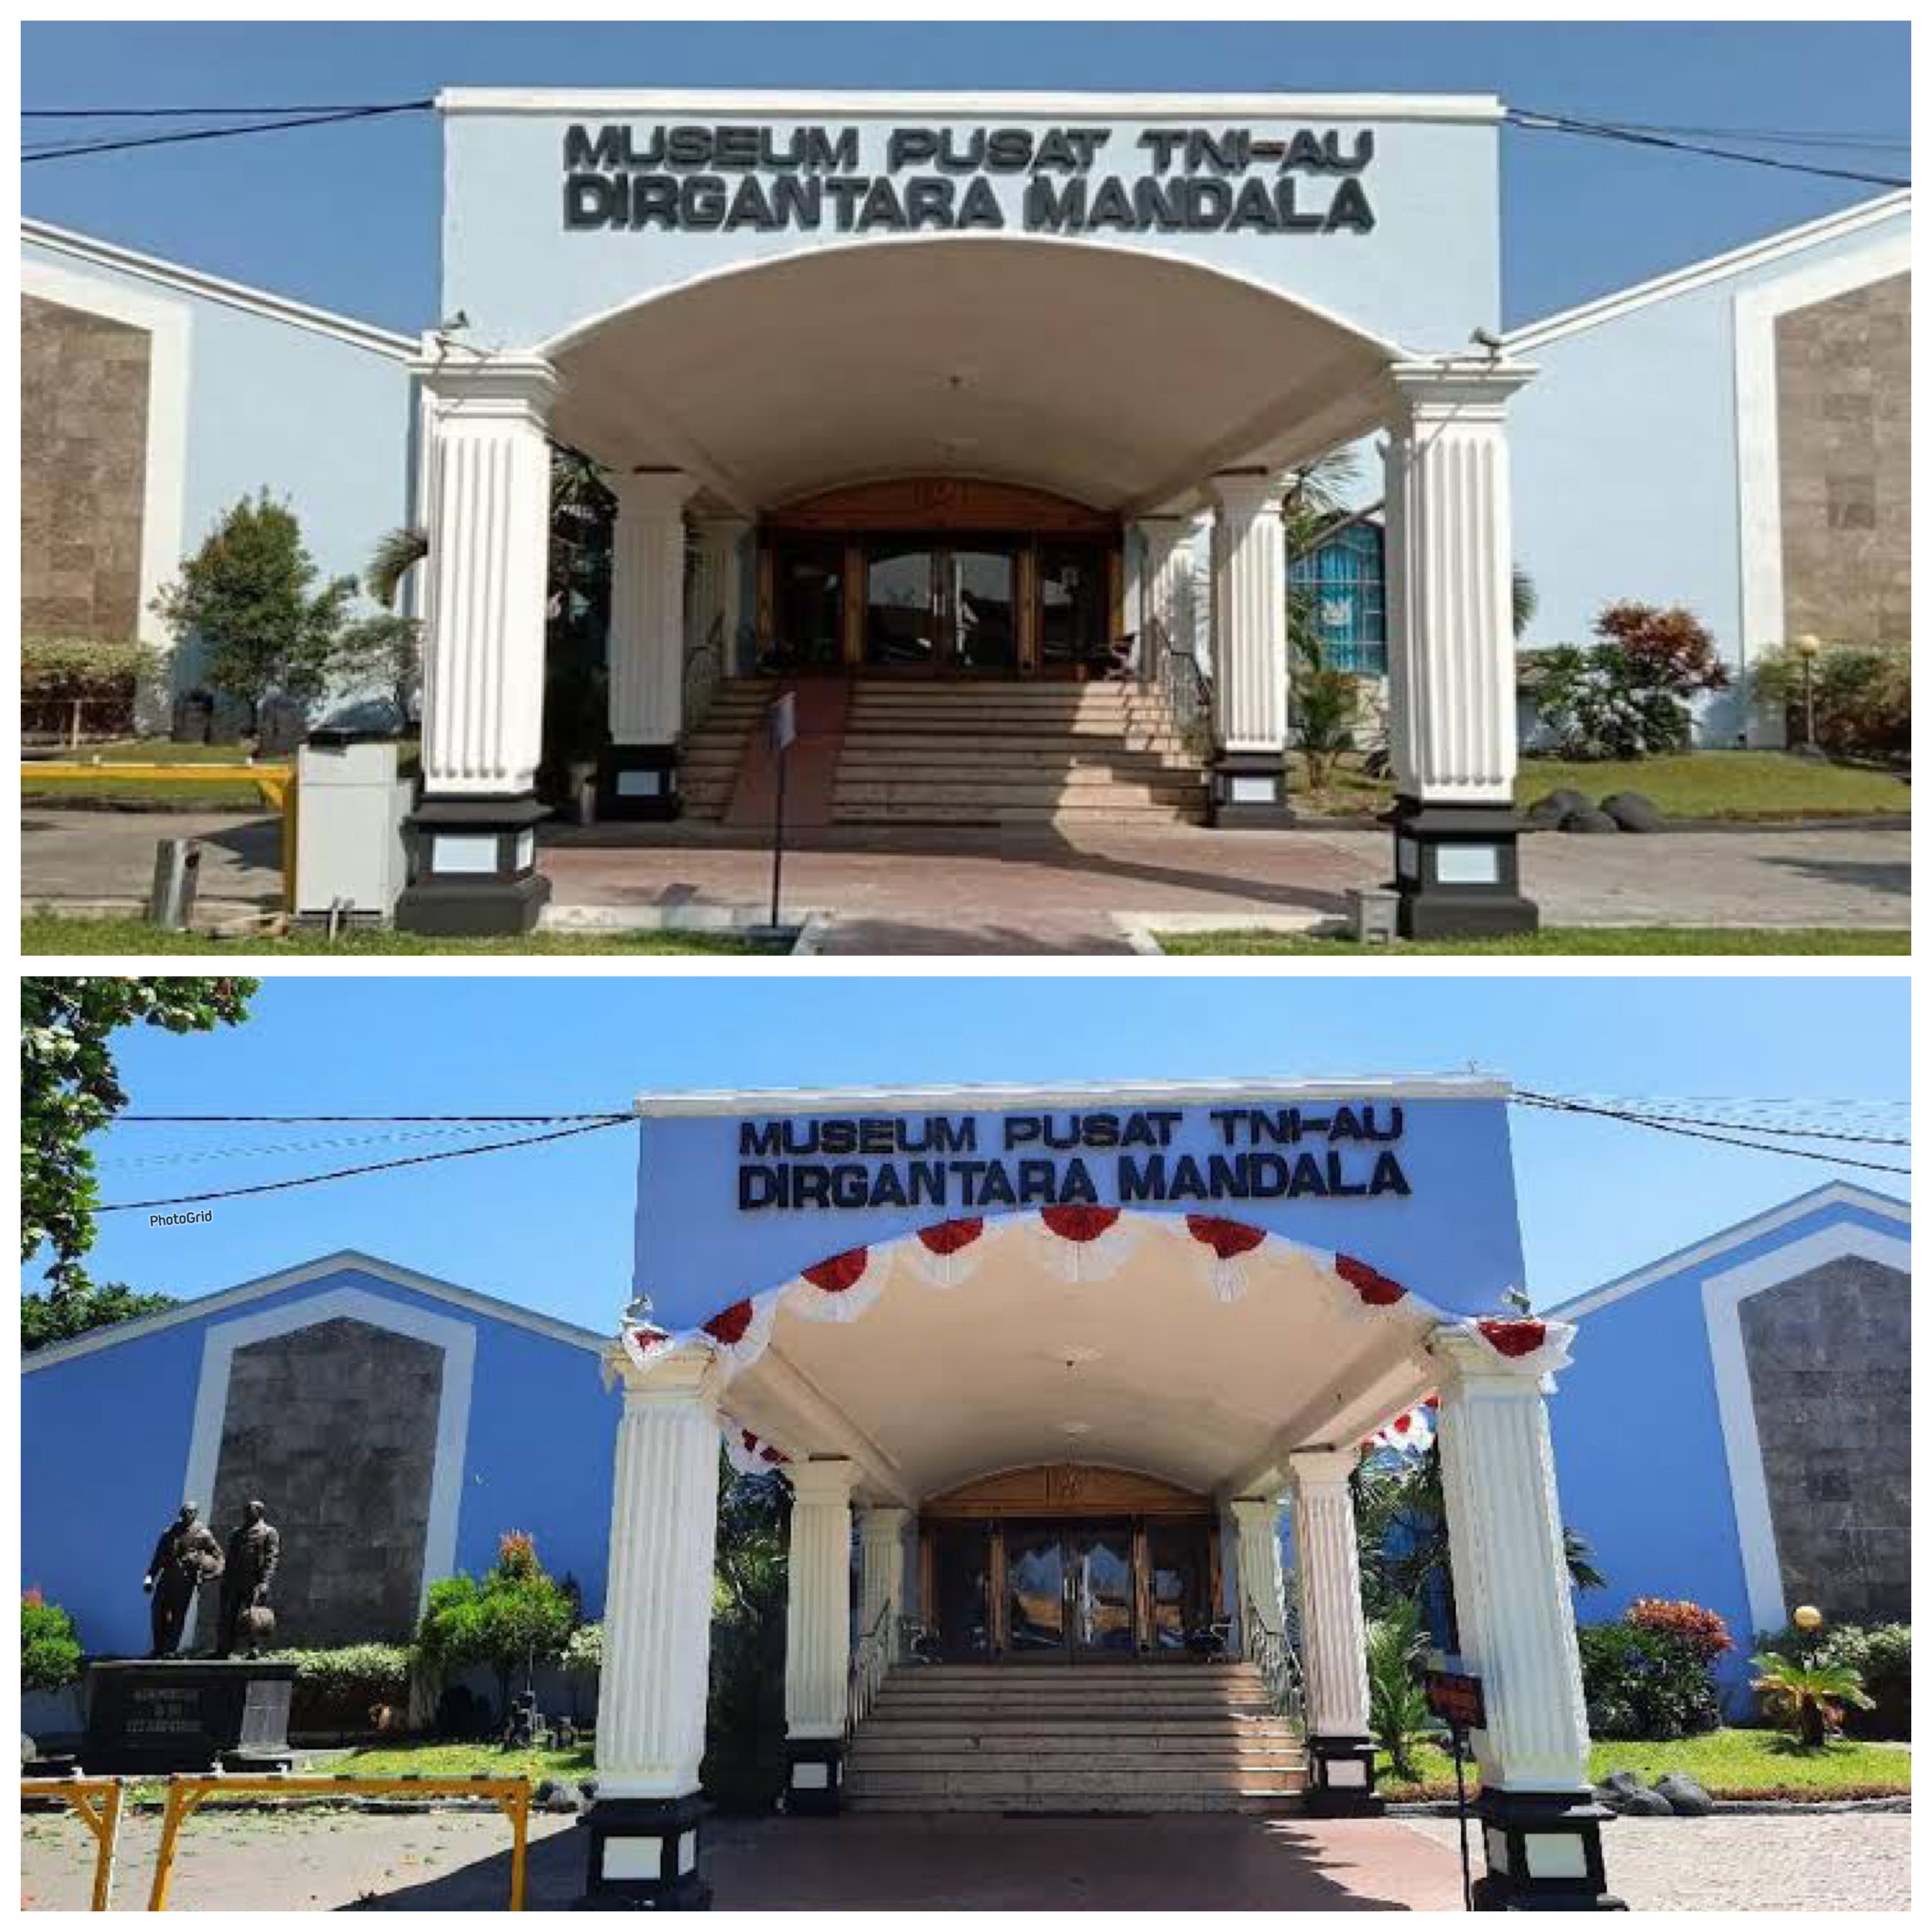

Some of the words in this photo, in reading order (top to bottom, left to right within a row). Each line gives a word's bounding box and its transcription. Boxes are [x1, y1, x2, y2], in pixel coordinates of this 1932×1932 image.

[564, 125, 858, 170] MUSEUM
[887, 126, 1111, 172] PUSAT
[1137, 129, 1374, 174] TNI-AU
[564, 173, 1004, 233] DIRGANTARA
[1024, 177, 1375, 235] MANDALA
[739, 1118, 975, 1157] MUSEUM
[1003, 1113, 1182, 1150] PUSAT
[1211, 1108, 1403, 1146] TNI-AU
[739, 1158, 1097, 1209] DIRGANTARA
[1118, 1151, 1411, 1202] MANDALA
